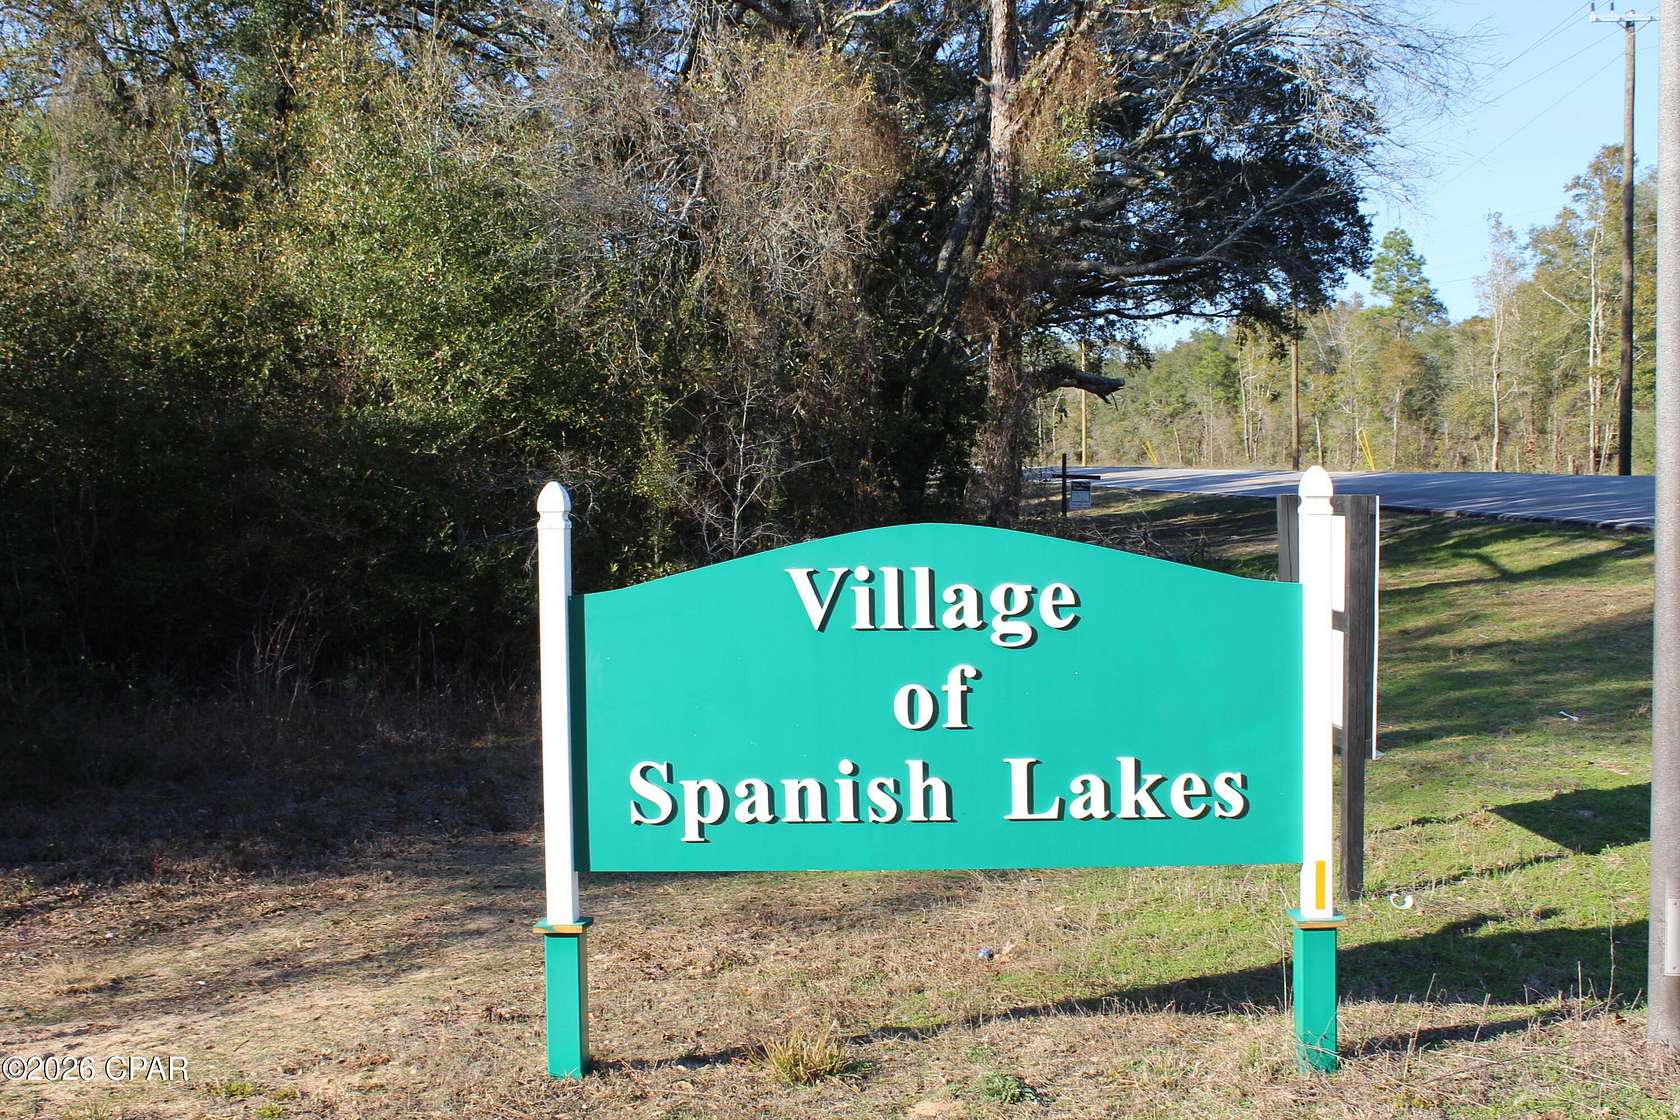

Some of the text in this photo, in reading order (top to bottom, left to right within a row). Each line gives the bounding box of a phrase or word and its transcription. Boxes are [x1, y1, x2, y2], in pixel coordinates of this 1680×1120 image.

[785, 565, 1081, 649] Village
[893, 663, 980, 731] of
[628, 756, 1248, 843] Spanish Lakes
